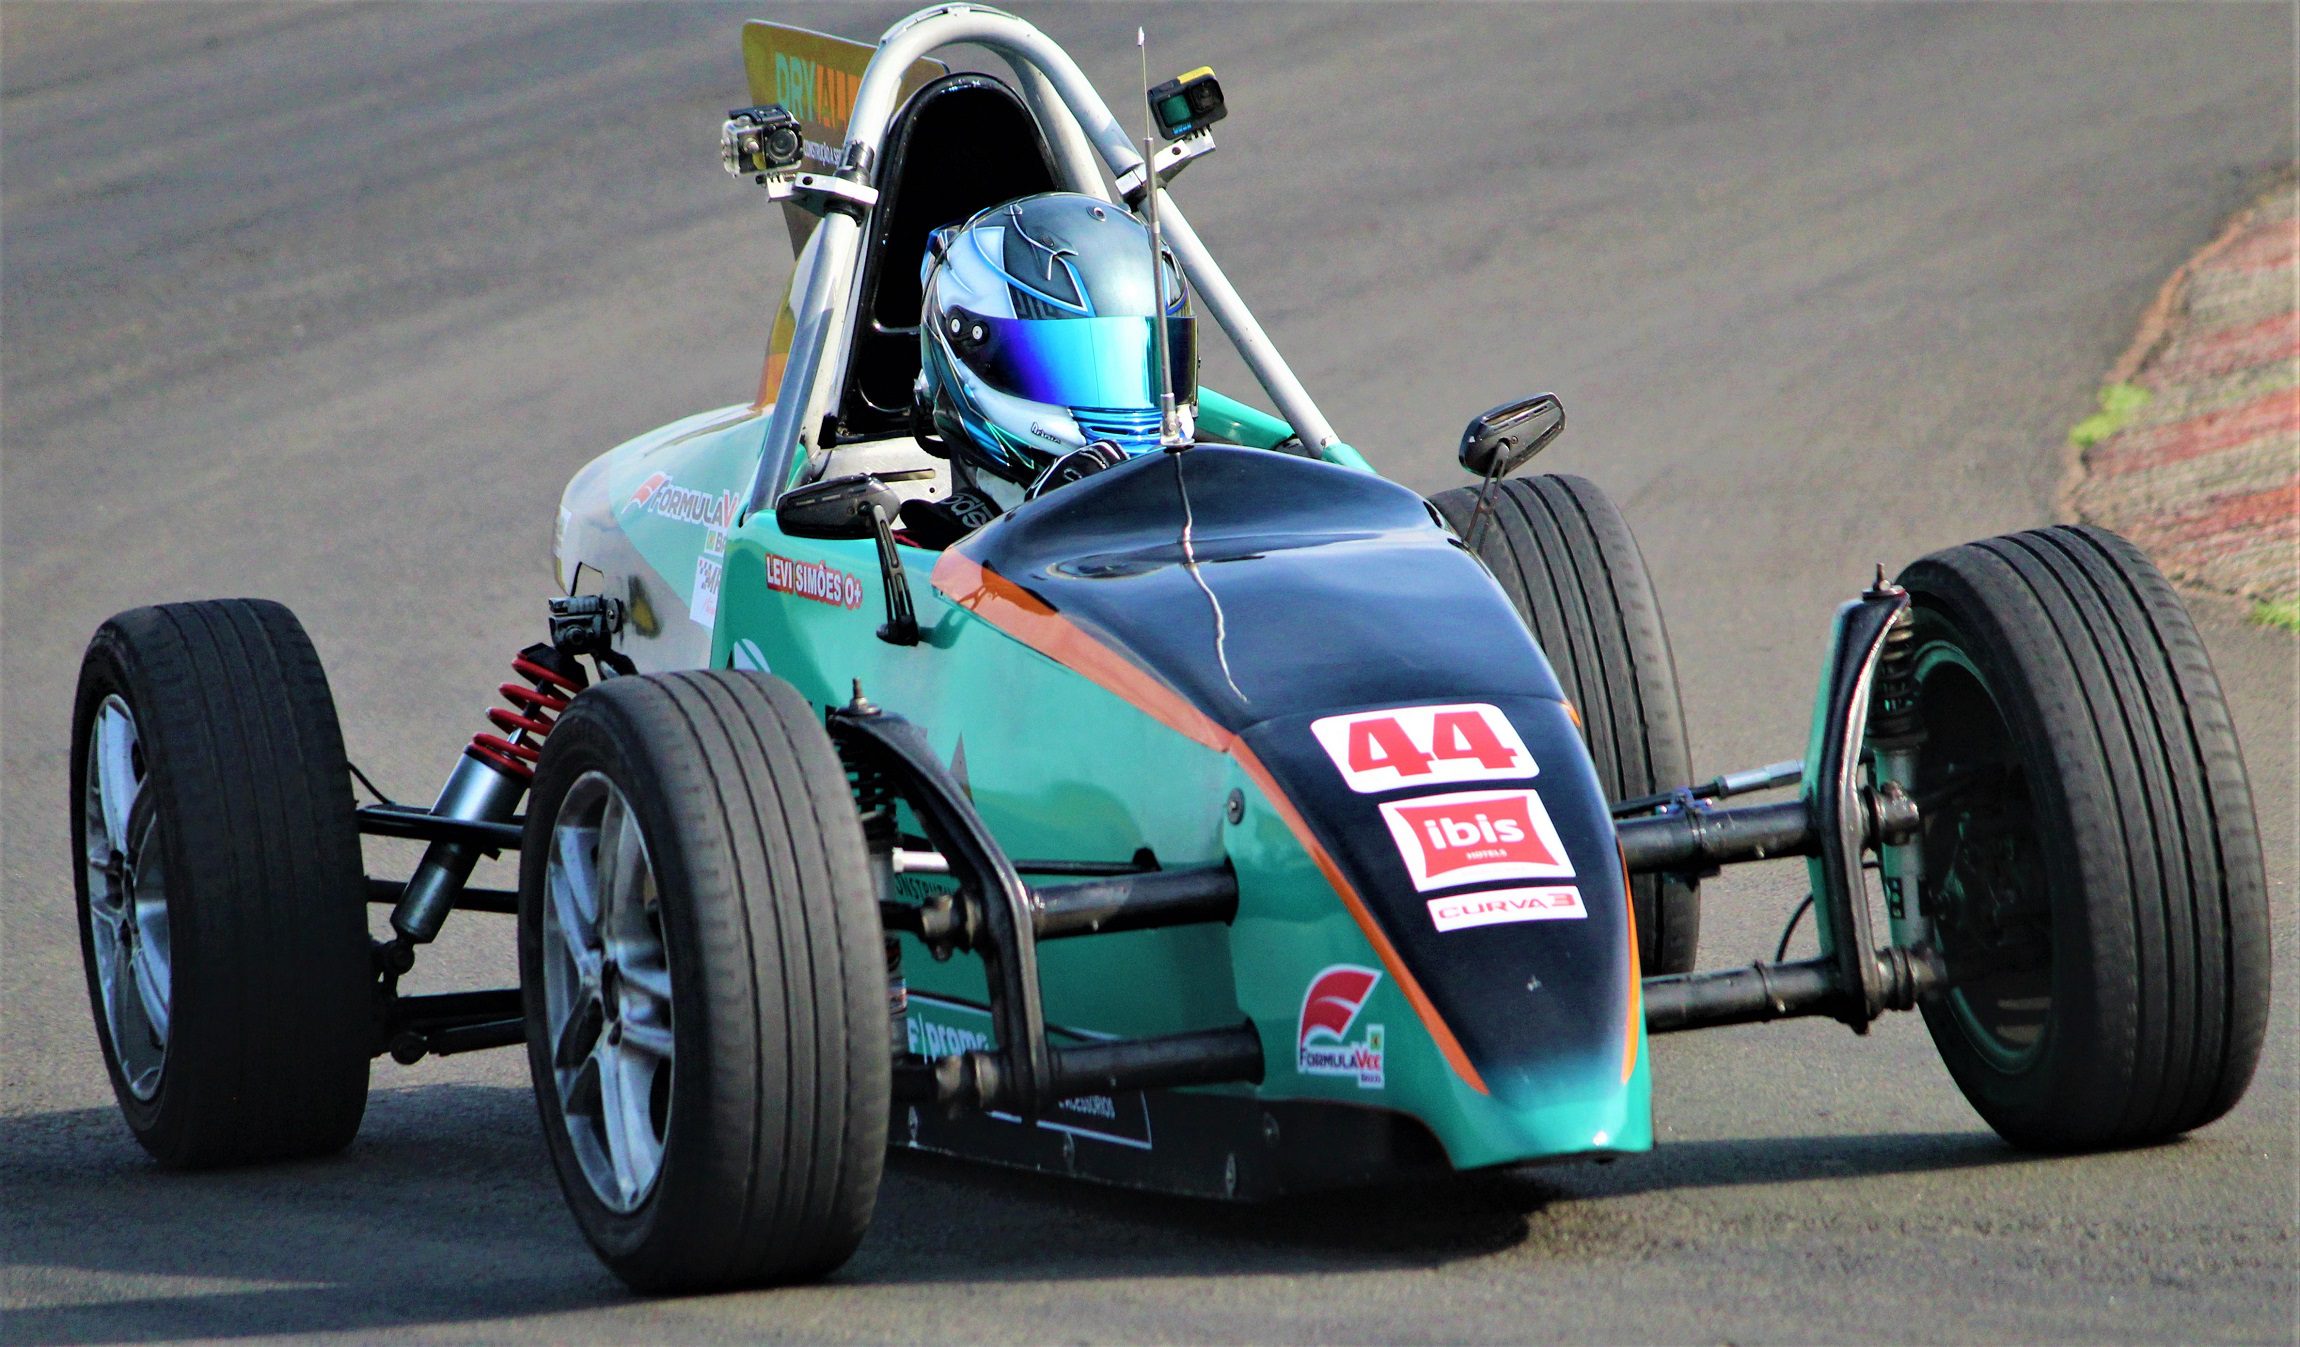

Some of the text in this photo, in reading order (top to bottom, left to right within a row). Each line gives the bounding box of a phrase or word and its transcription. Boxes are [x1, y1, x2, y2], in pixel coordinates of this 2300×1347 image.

[651, 478, 739, 529] FORMULAV
[766, 556, 793, 590] LEVI
[1348, 711, 1518, 777] 44
[1424, 814, 1525, 850] ibis
[1466, 849, 1508, 860] HOTELS
